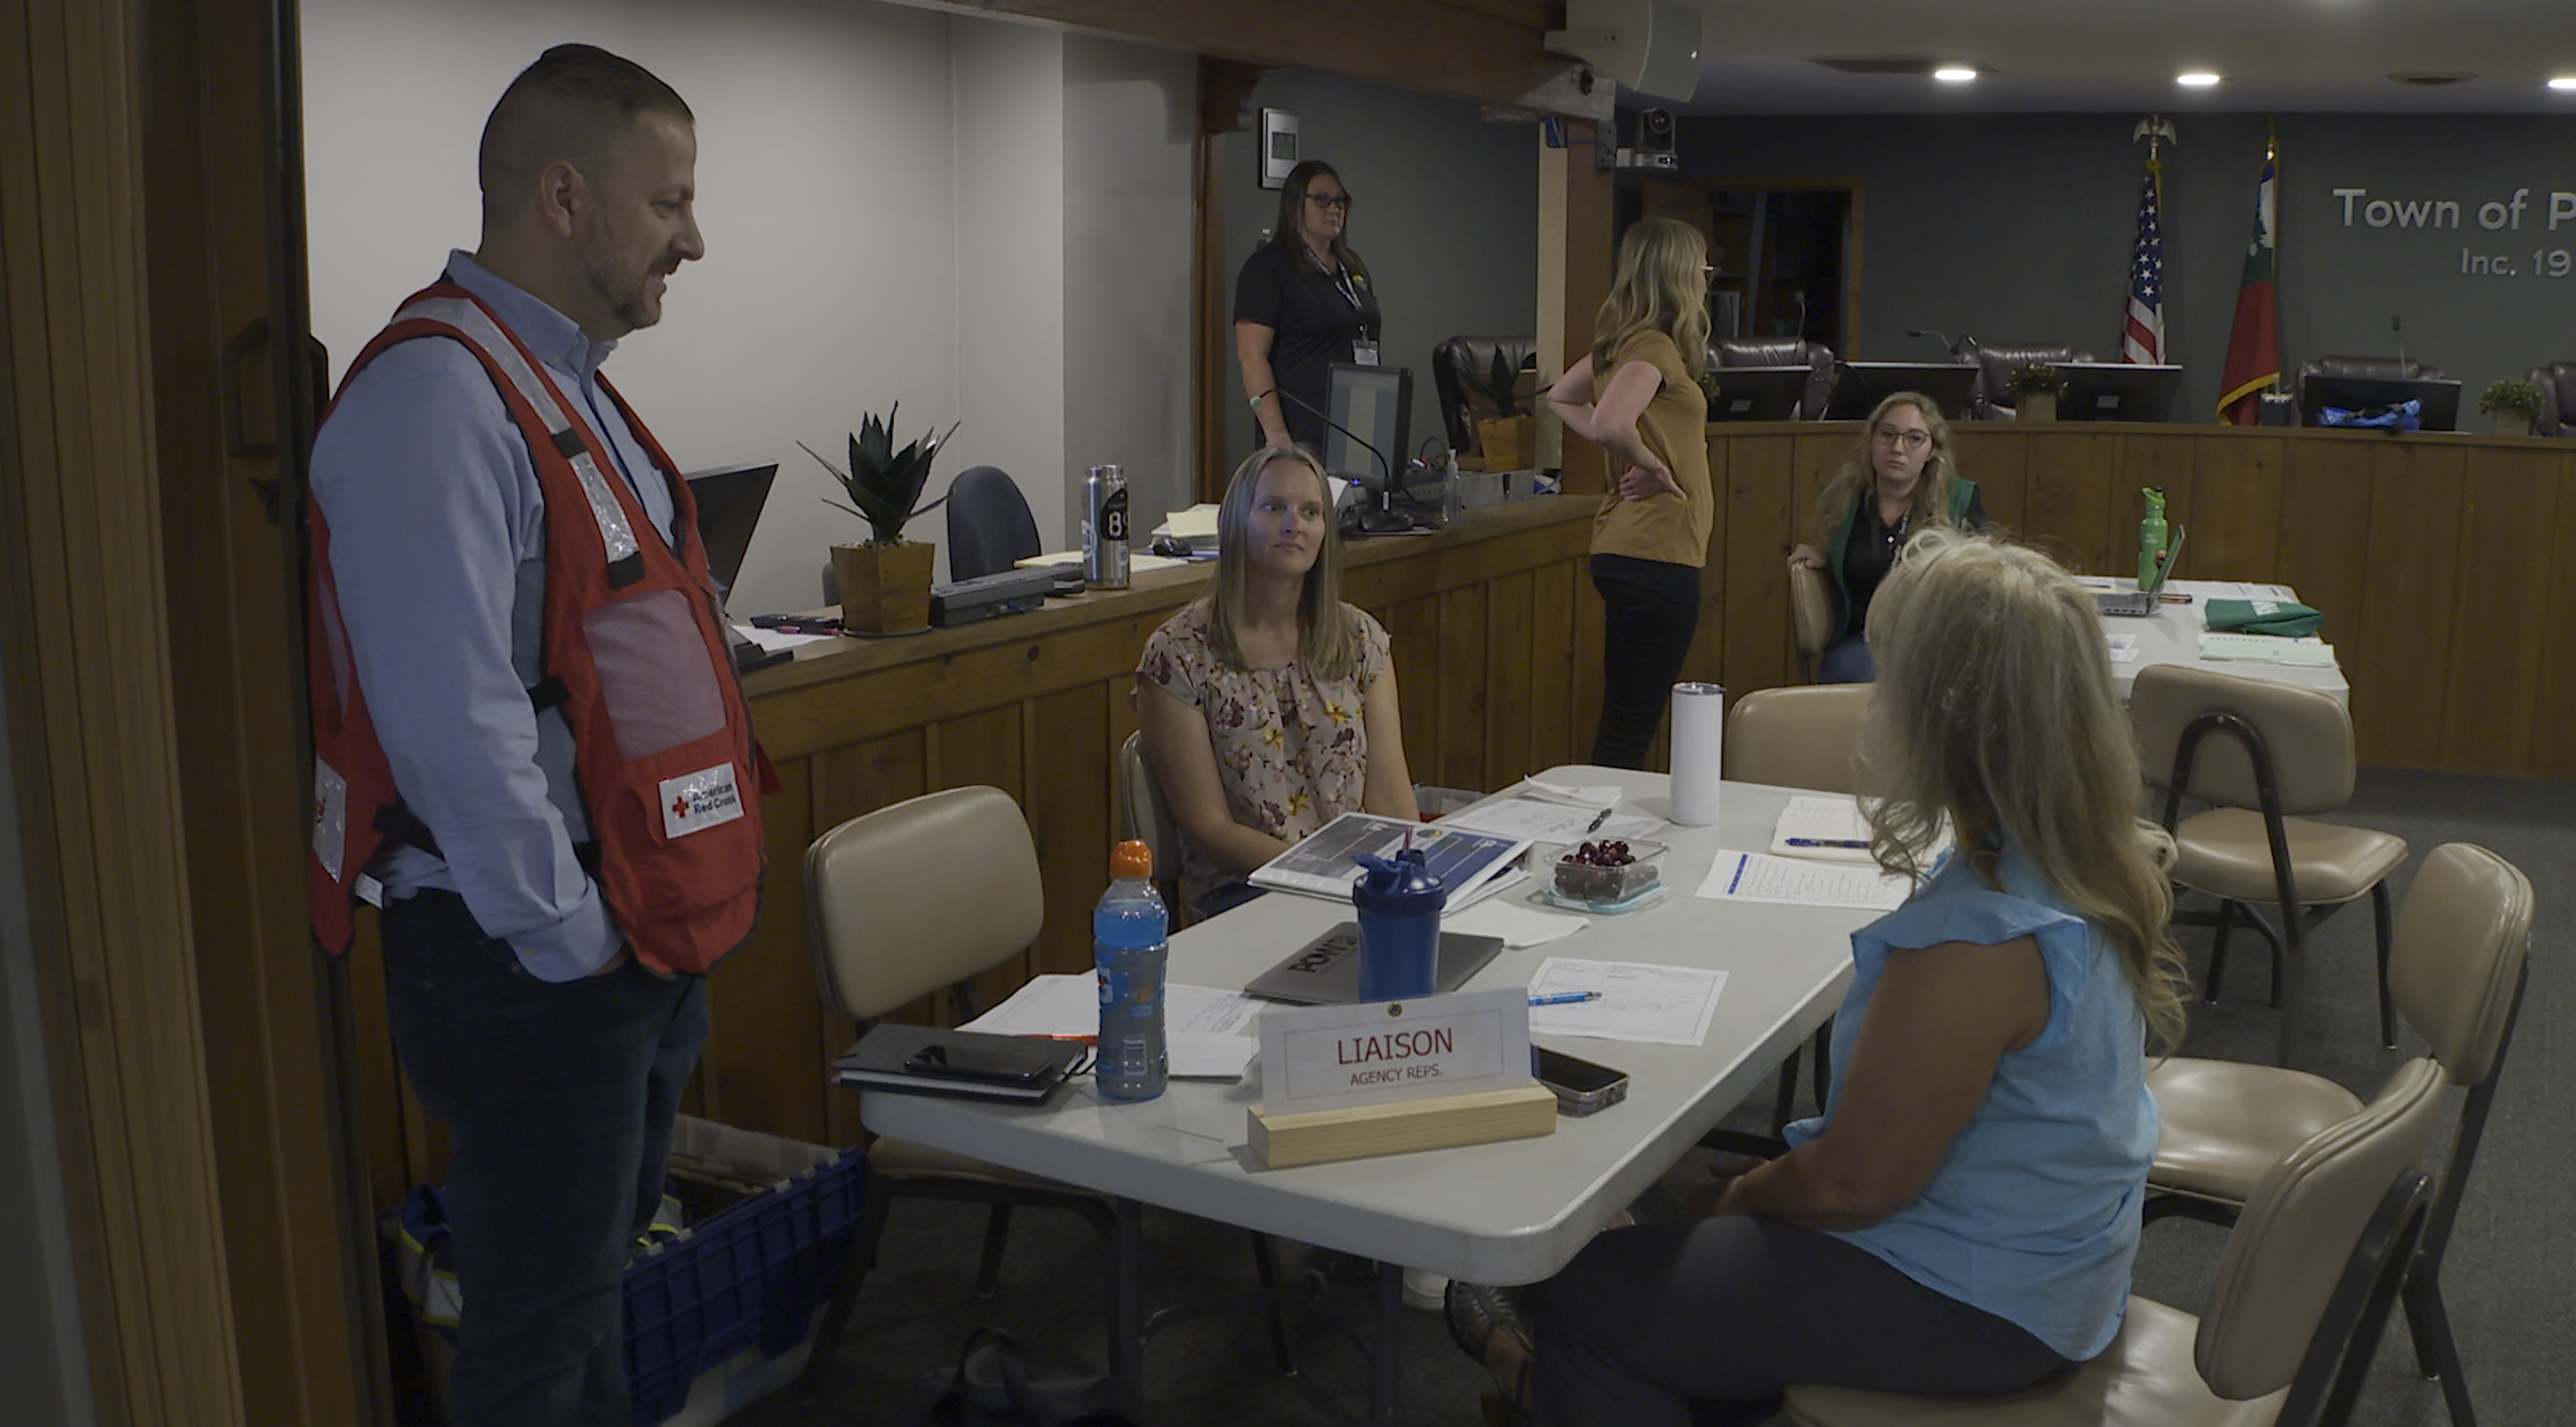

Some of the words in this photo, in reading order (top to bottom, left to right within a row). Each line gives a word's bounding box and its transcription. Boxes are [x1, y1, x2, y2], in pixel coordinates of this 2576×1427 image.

[2331, 188, 2460, 228] Town
[2477, 188, 2530, 231] of
[2547, 192, 2576, 231] P
[2461, 247, 2517, 277] Inc.
[2532, 249, 2572, 278] 19
[693, 783, 732, 802] American
[694, 799, 712, 813] Red
[714, 796, 735, 808] Cross
[1338, 1027, 1453, 1066] LIAISON
[1350, 1068, 1403, 1086] AGENCY
[1406, 1063, 1443, 1079] REPS.
